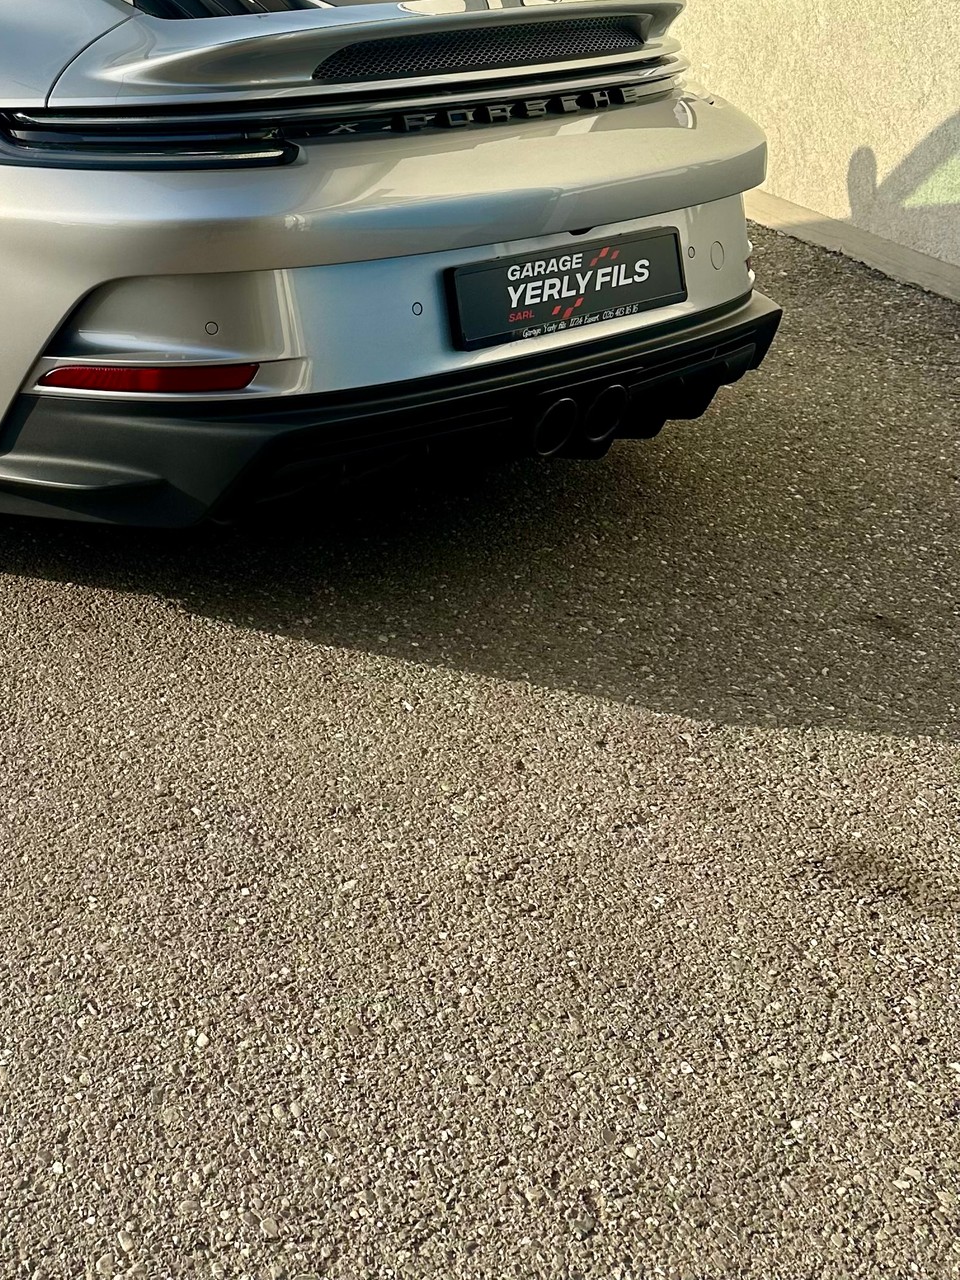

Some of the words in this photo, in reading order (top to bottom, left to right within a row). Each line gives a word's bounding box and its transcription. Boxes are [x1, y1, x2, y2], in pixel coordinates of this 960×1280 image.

[403, 86, 639, 132] PORSCHE
[507, 253, 583, 281] GARAGE
[507, 270, 593, 308] YERLY
[595, 259, 650, 291] FILS
[508, 310, 535, 323] SARL
